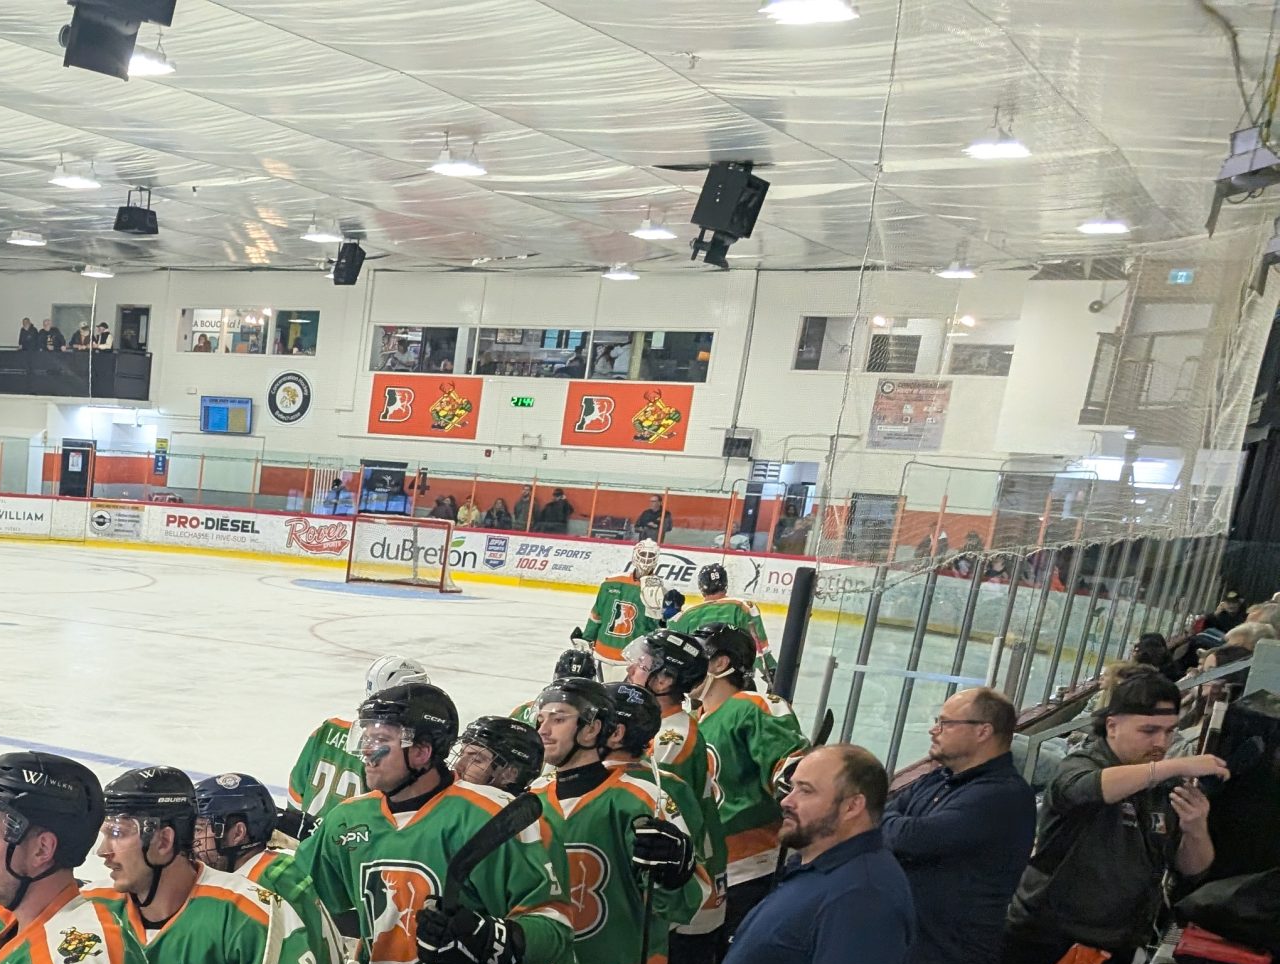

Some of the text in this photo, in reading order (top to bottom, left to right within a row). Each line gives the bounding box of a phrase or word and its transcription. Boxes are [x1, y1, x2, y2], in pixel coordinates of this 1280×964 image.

[164, 530, 210, 542] BELLECHASSE
[369, 535, 478, 569] duBreton
[515, 542, 593, 560] BPM SPORTS
[515, 557, 549, 572] 100.9
[571, 663, 582, 673] 97
[423, 713, 446, 723] CCM
[138, 767, 156, 779] W
[22, 769, 73, 791] W WLKN
[157, 796, 188, 804] BAUER
